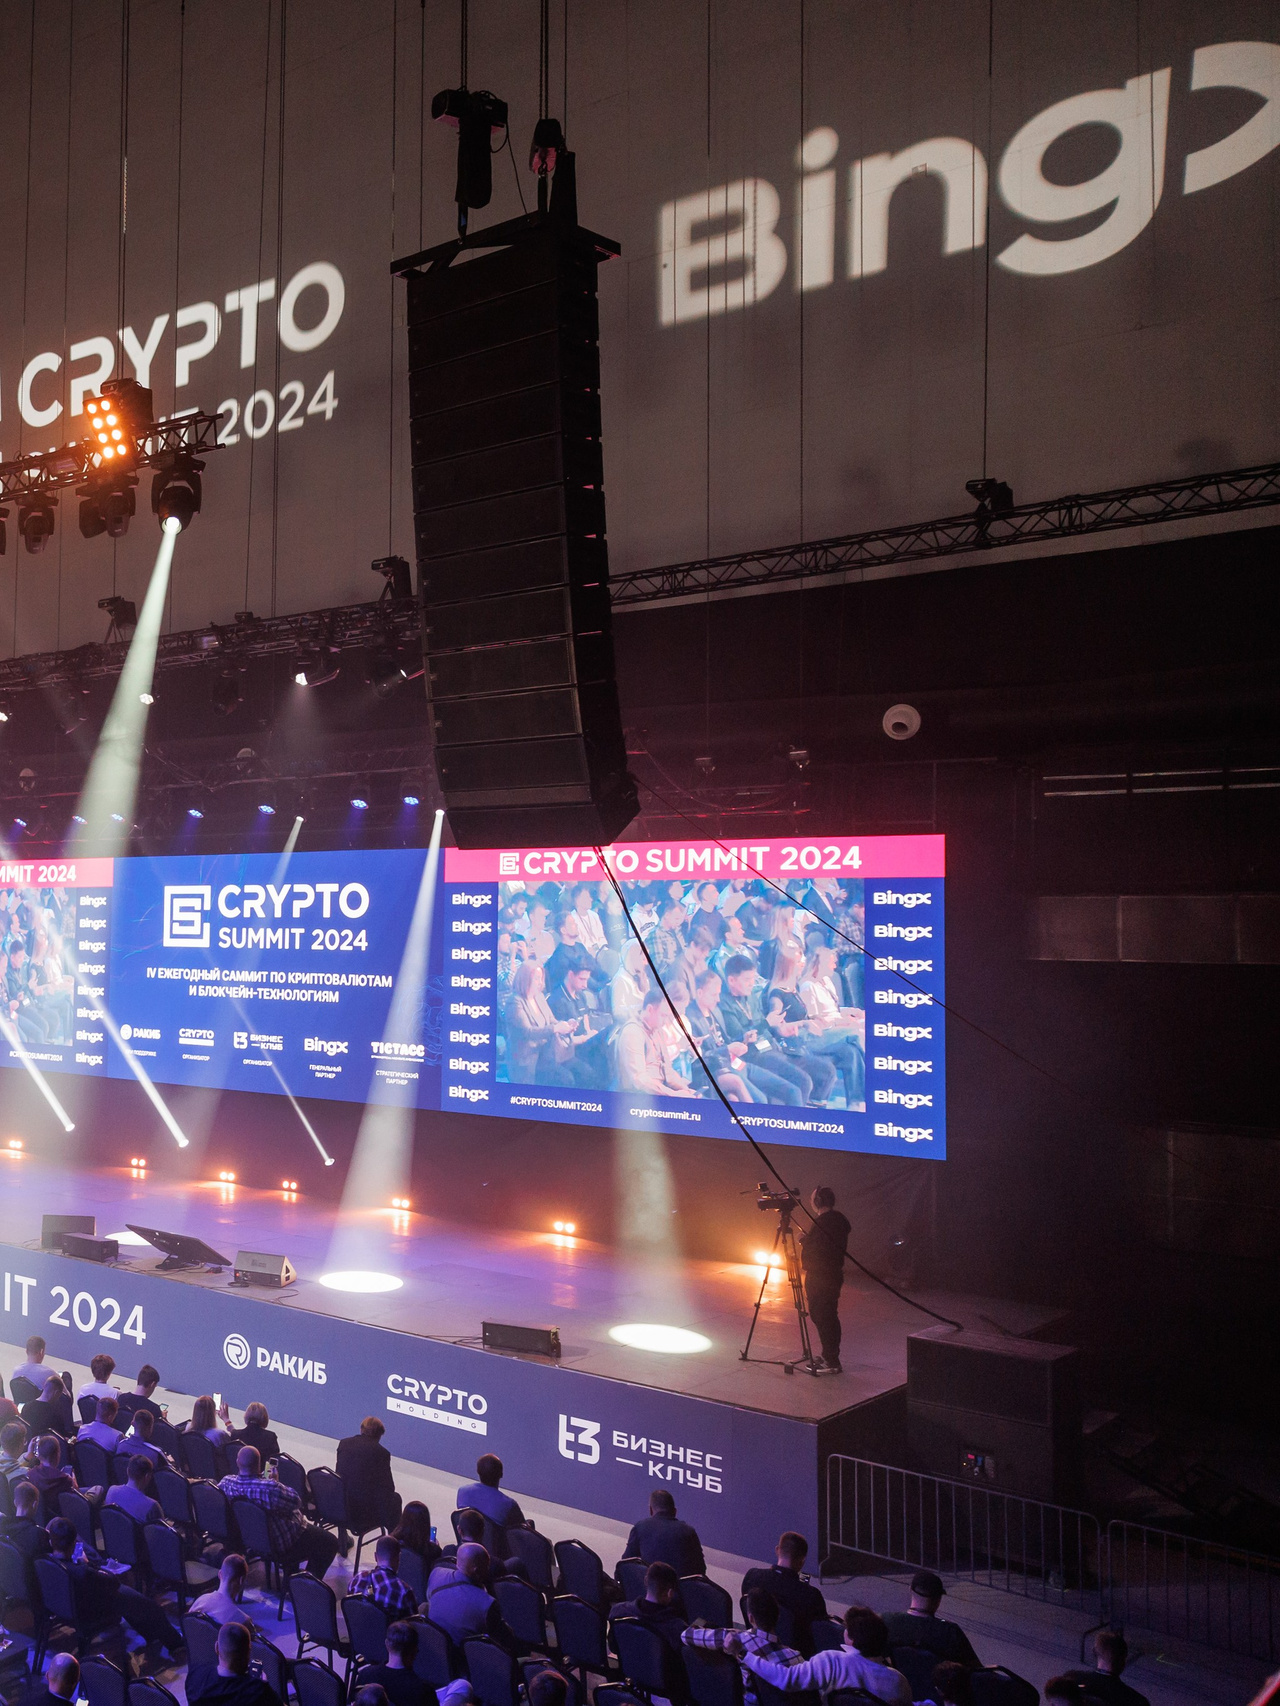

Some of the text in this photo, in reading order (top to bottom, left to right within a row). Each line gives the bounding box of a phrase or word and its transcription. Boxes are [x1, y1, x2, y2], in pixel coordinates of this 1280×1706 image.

[17, 261, 345, 428] CRYPTO
[218, 370, 338, 446] 2024
[523, 845, 862, 874] CRYPTO SUMMIT 2024
[37, 865, 77, 882] 2024
[218, 882, 370, 919] CRYPTO
[218, 927, 368, 951] SUMMIT 2024
[146, 967, 392, 988] IV ЕЖЕГОДНЫЙ САММИТ ПО КРИПТОВАЛЮТАМ
[189, 984, 339, 1003] И БЛОКЧЕЙН-ТЕХНОЛОГИЯМ
[179, 1028, 214, 1039] CRYPTO
[250, 1034, 283, 1043] БИЗНЕС
[510, 1096, 602, 1112] #CRYPTOSUMMIT2024
[630, 1107, 701, 1122] cryptosummit.ru
[730, 1115, 844, 1135] #CRYPTOSUMMIT2024
[49, 1285, 147, 1346] 2024
[256, 1346, 327, 1385] РАКИБ
[387, 1374, 488, 1415] CRYPTO
[396, 1403, 476, 1429] HOLDING
[612, 1430, 723, 1472] БИЗНЕС
[648, 1460, 723, 1493] КЛУБ
